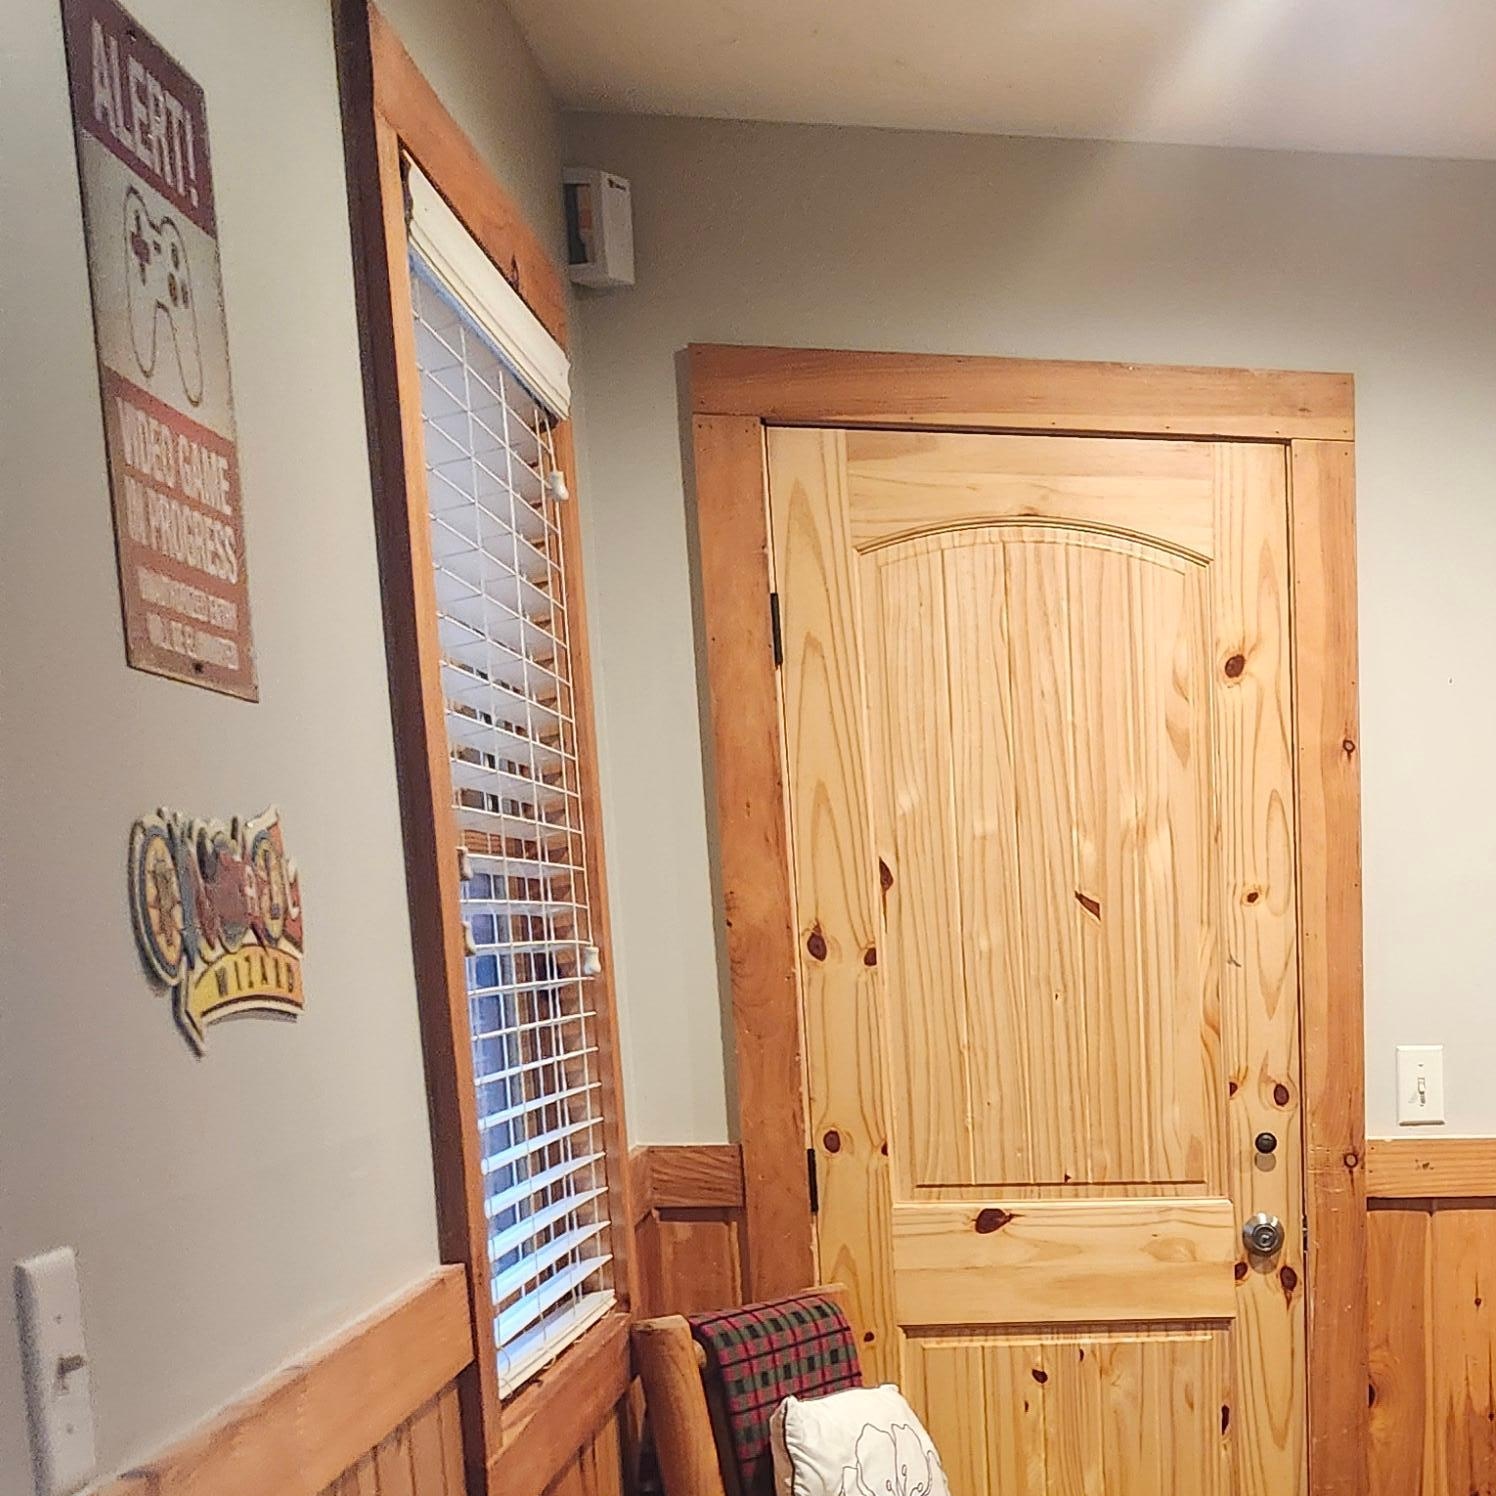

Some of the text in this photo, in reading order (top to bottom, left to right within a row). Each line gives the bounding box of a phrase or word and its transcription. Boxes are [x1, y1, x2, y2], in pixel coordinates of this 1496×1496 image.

[91, 16, 198, 209] ALERT!
[117, 397, 231, 516] VIDEO GAME
[150, 487, 238, 584] PROGRESS
